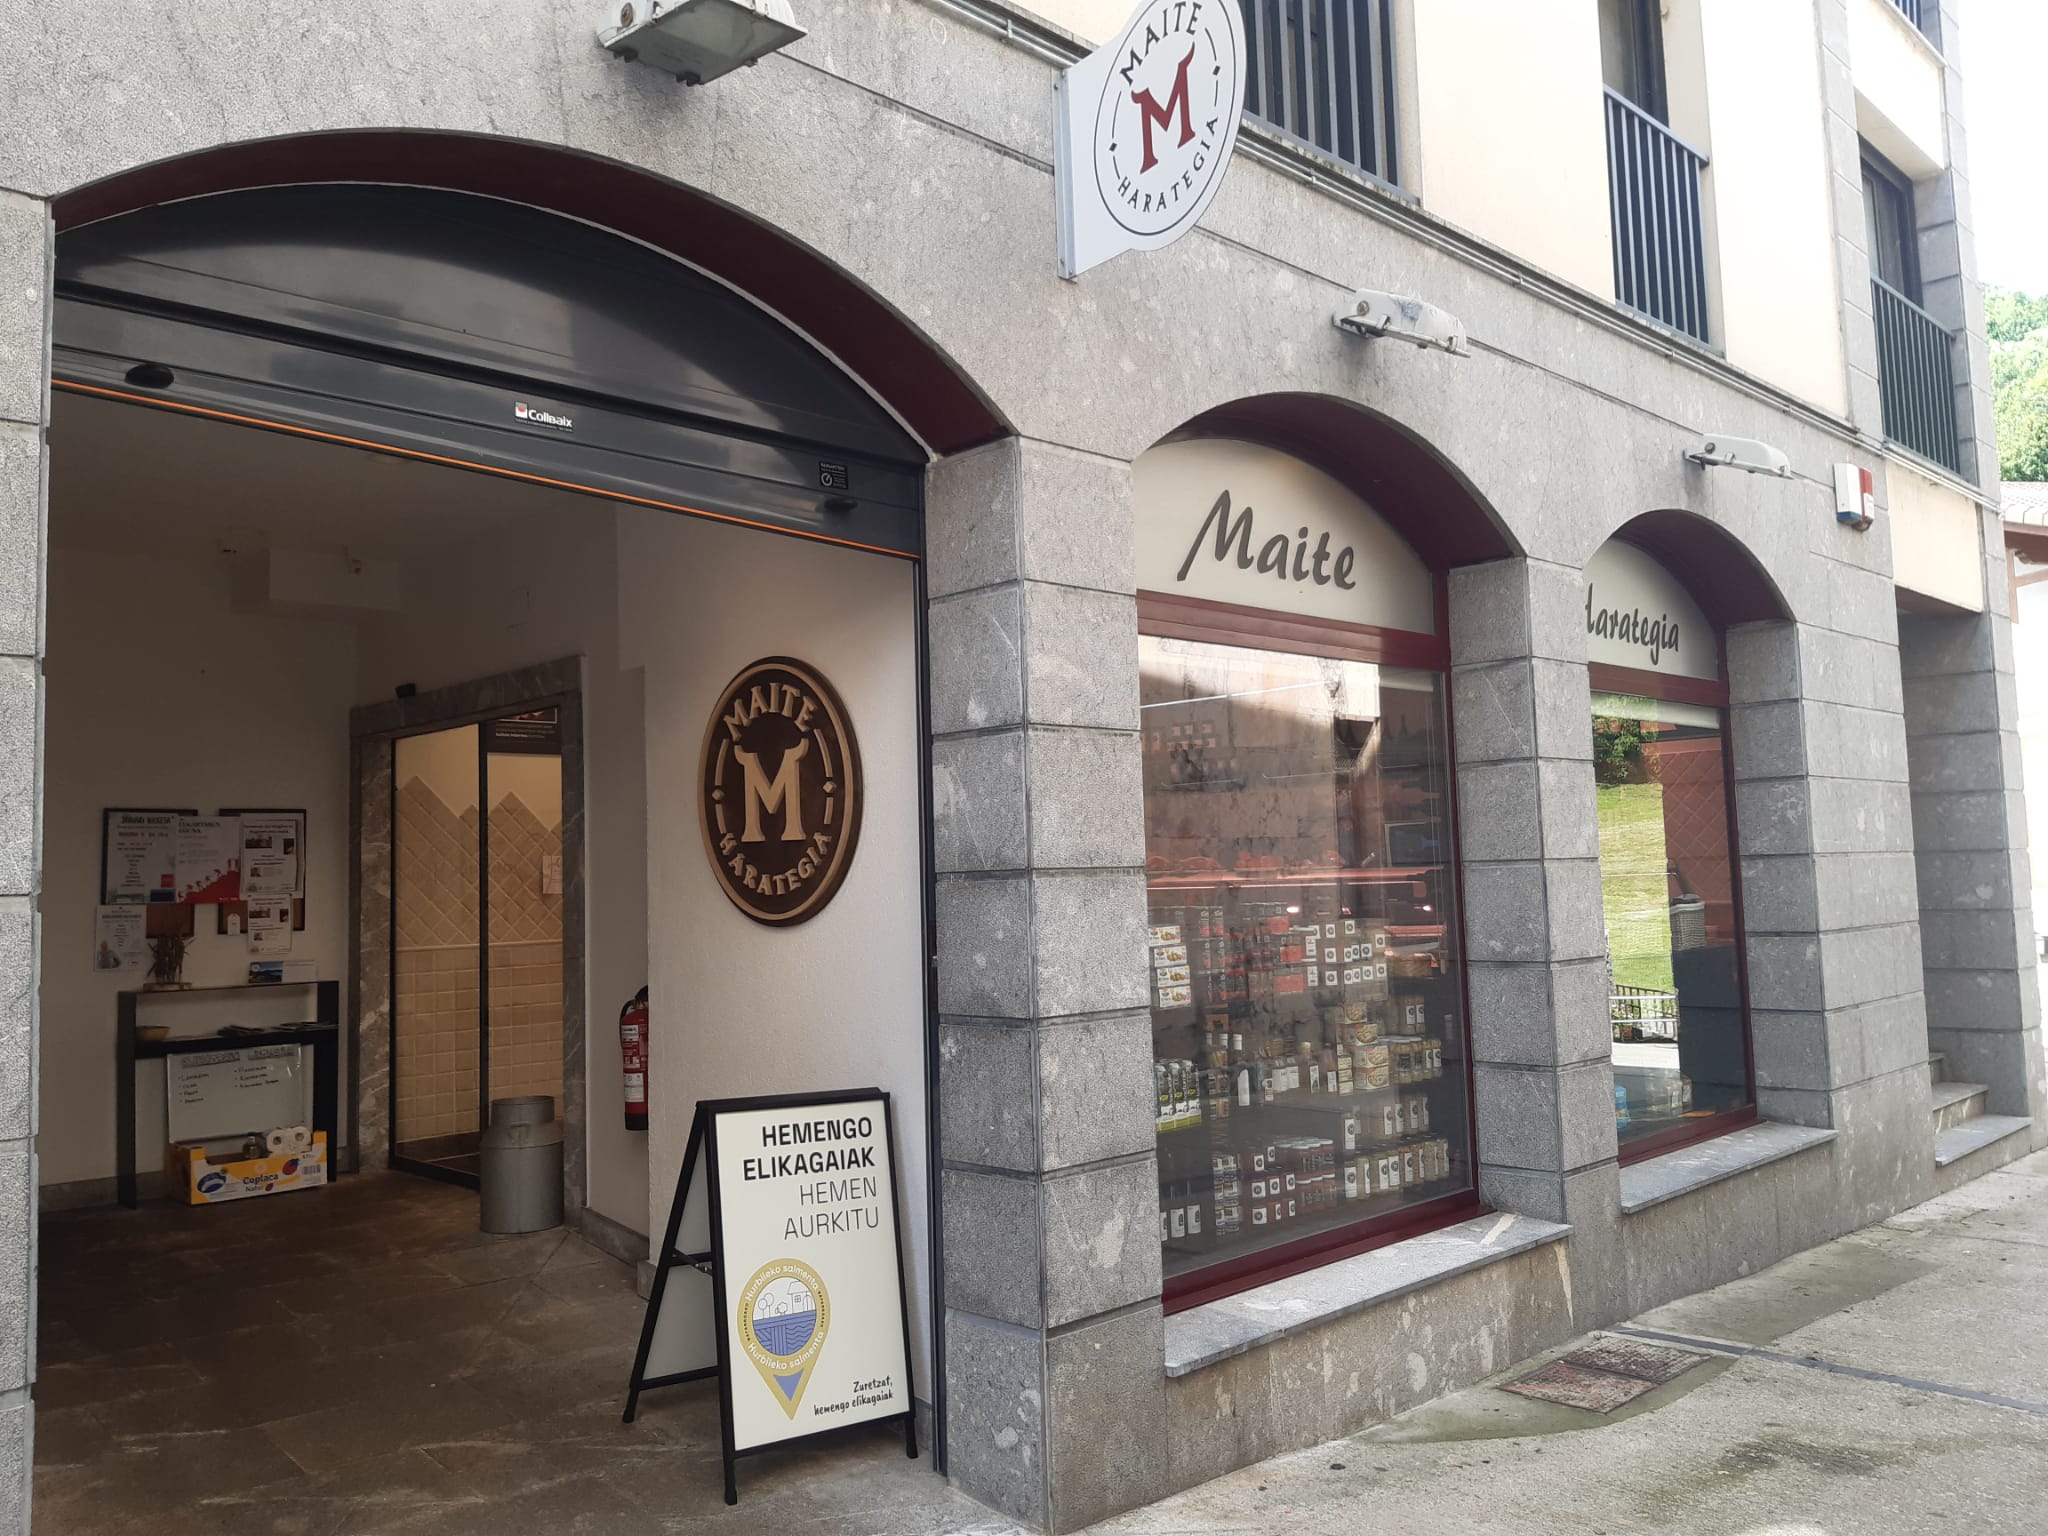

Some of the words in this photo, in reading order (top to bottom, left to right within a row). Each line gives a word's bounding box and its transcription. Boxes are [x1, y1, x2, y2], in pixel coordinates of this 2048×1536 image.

[1120, 2, 1203, 86] MAITE
[1131, 41, 1196, 175] M
[1118, 117, 1219, 213] HARATEGIA
[1176, 489, 1356, 590] Maite
[723, 682, 819, 742] MAITE
[734, 738, 809, 842] M
[719, 831, 833, 896] HARATEGIA
[762, 1116, 872, 1148] HEMENGO
[743, 1146, 876, 1181] ELIKAGAIAK
[800, 1176, 877, 1205] HEMEN
[784, 1206, 879, 1240] AURKITU
[745, 1266, 781, 1302] Hurbileko
[783, 1264, 819, 1290] salmenta
[748, 1342, 787, 1370] Hurbileko
[790, 1331, 824, 1367] salmenta
[814, 1401, 850, 1416] hemengo
[852, 1389, 893, 1407] elikagaiak
[853, 1375, 893, 1393] Zuretzat,
